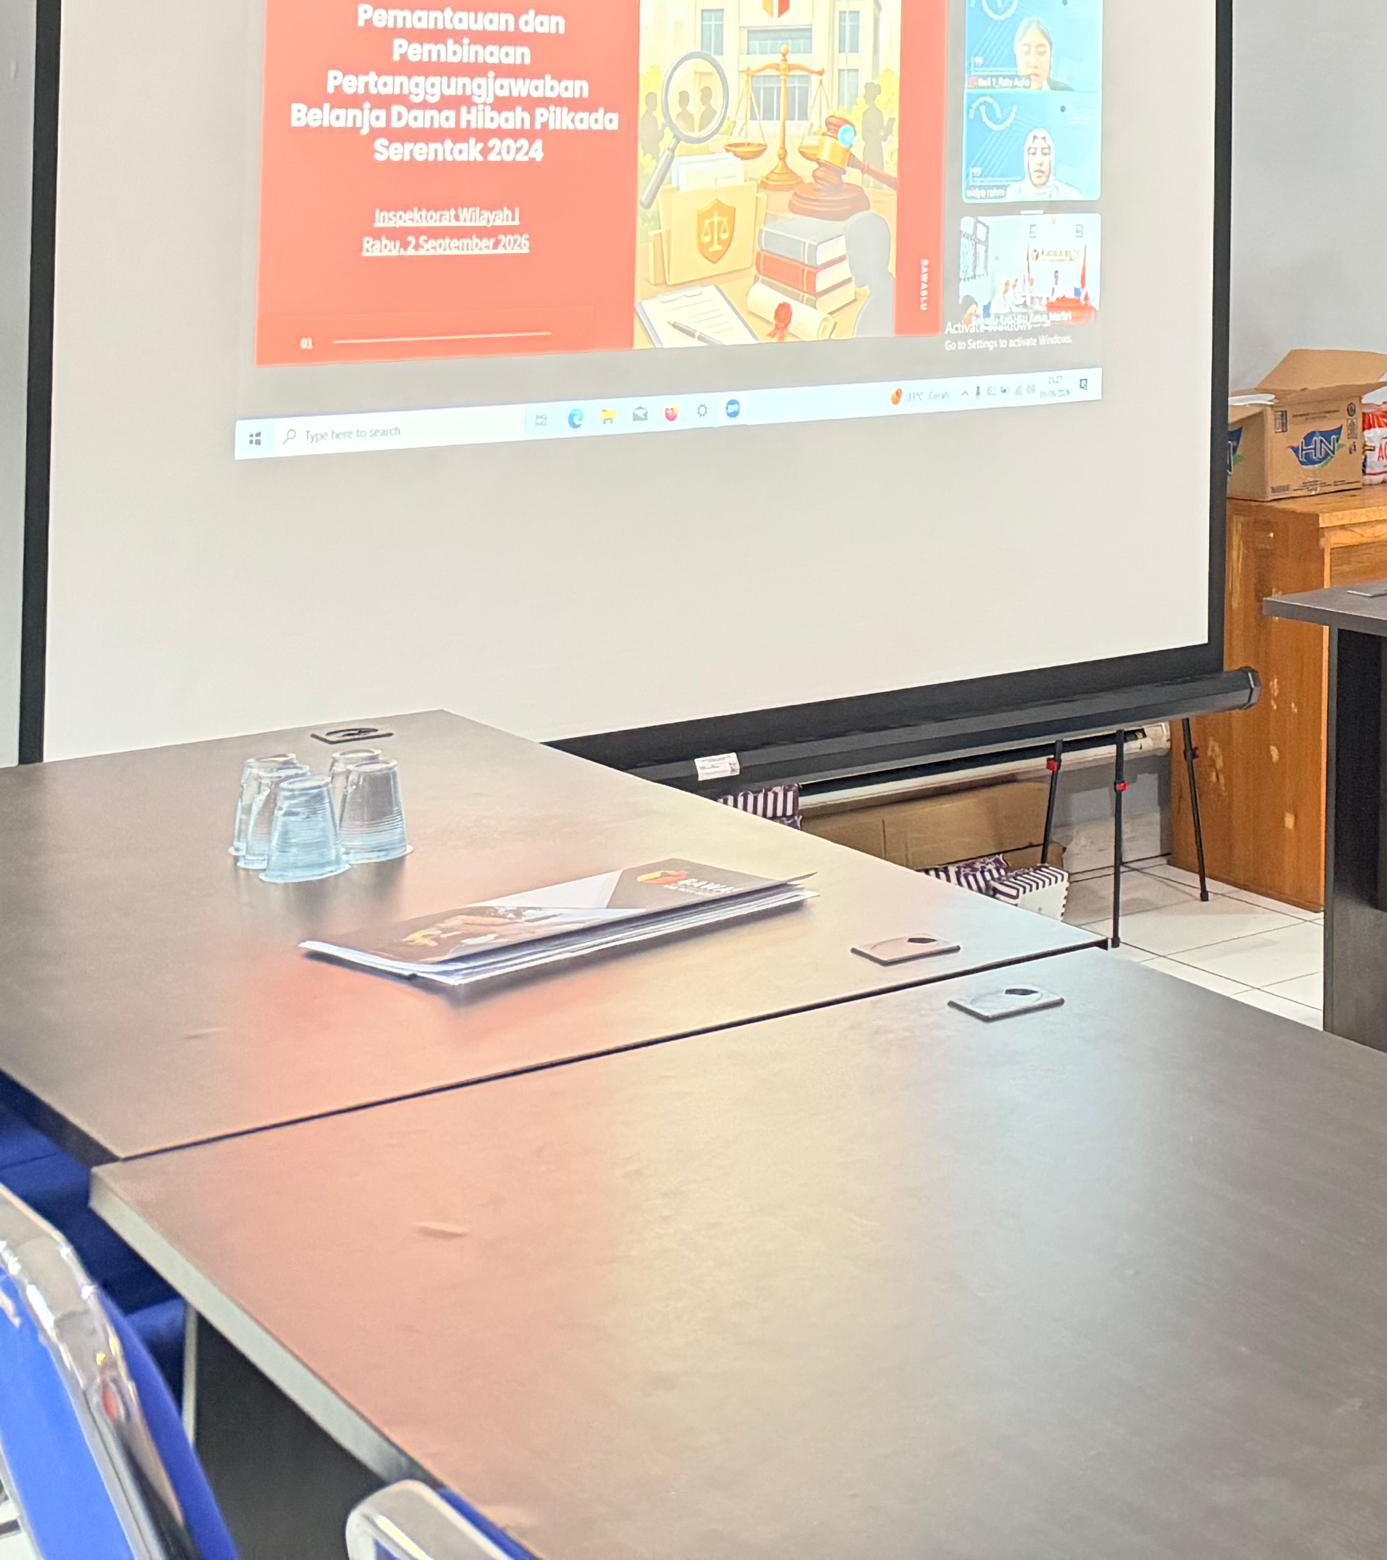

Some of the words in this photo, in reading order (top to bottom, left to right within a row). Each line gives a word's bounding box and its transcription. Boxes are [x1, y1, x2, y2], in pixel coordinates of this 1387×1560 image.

[357, 3, 515, 32] Pemantauan
[518, 9, 566, 34] dan
[392, 38, 531, 65] Pembinaan
[326, 70, 589, 103] Pertanggungjawaban
[290, 102, 386, 135] Belanja
[391, 105, 455, 129] Dana
[459, 102, 530, 130] Hibah
[534, 104, 619, 131] Pilkada
[374, 138, 483, 162] Serentak
[487, 138, 544, 162] 2024
[375, 207, 455, 226] Inspektorat
[458, 206, 513, 226] Wilayah
[362, 236, 404, 254] Rabu,
[406, 235, 416, 252] 2
[419, 234, 496, 253] September
[920, 259, 929, 311] BAWASLU
[300, 338, 313, 349] 01
[944, 339, 957, 351] Go
[958, 340, 967, 350] to
[967, 337, 998, 351] Settings
[999, 337, 1008, 349] to
[306, 429, 329, 443] Type
[331, 429, 353, 440] here
[356, 428, 367, 439] to
[369, 426, 401, 438] search
[1299, 436, 1338, 460] HN
